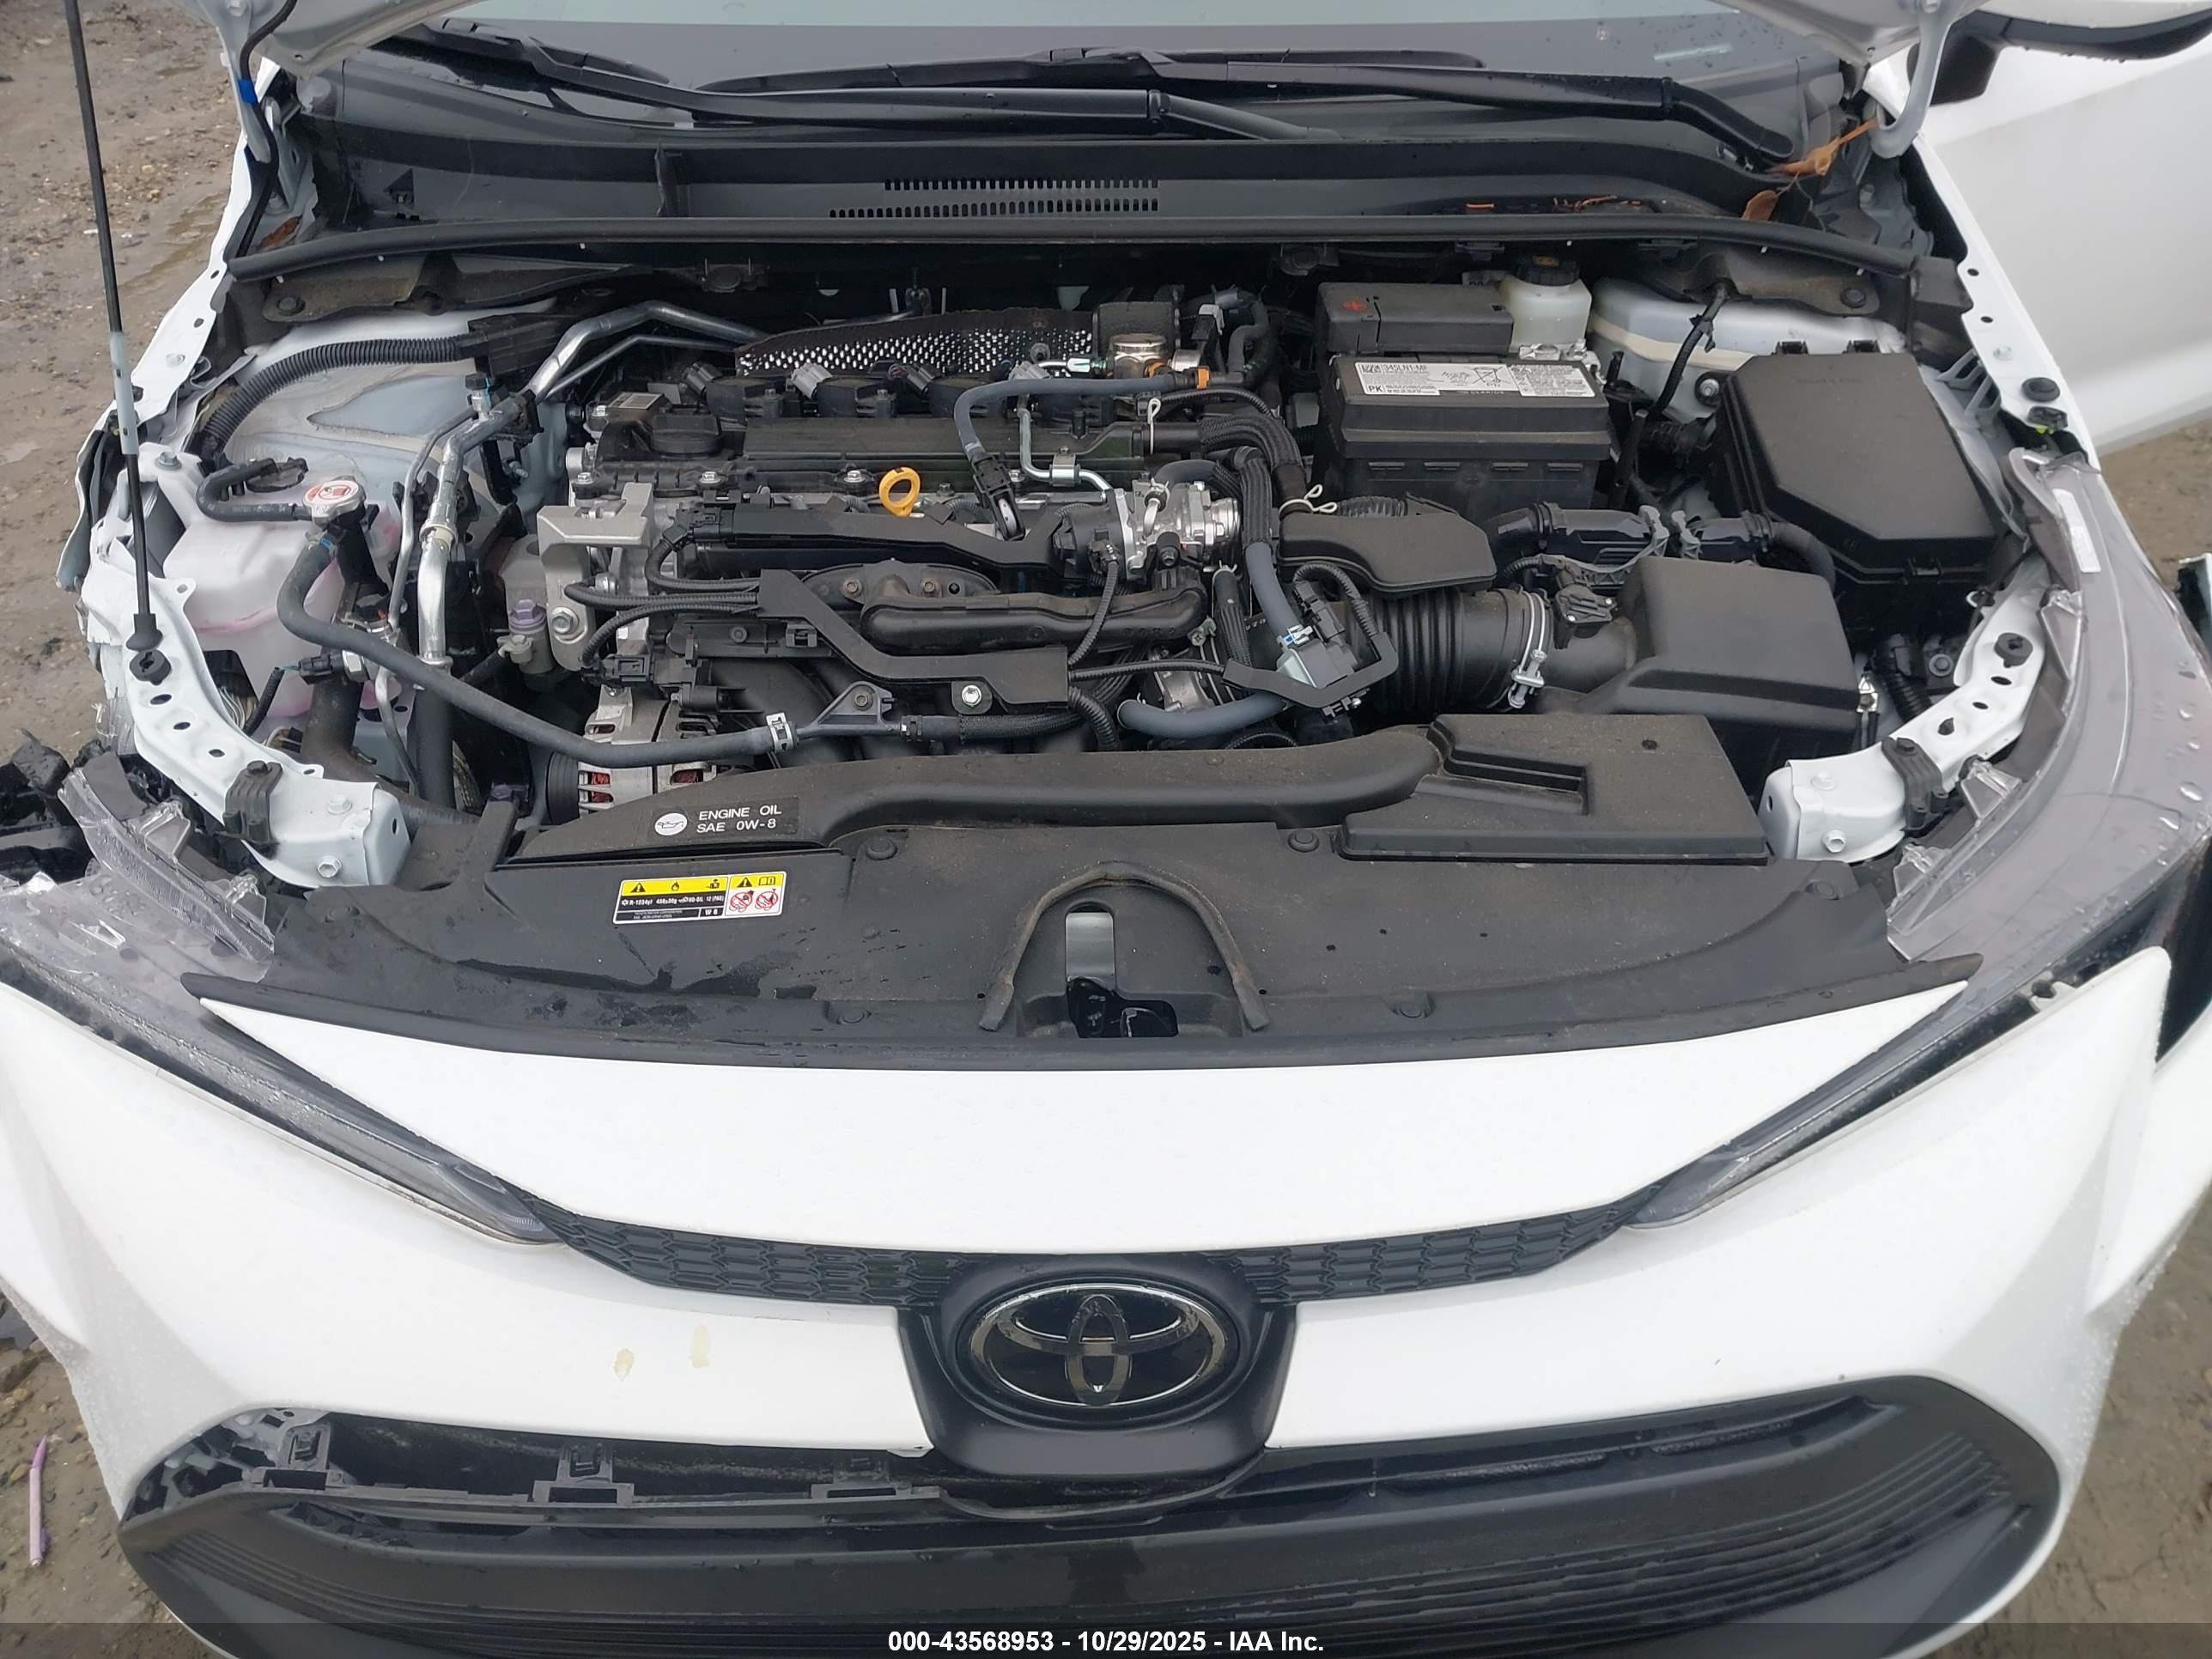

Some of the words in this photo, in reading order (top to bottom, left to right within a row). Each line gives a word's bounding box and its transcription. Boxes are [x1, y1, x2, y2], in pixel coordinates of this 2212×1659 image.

[698, 806, 750, 820] ENGINE
[759, 804, 782, 816] OIL
[696, 822, 726, 834] SAE
[736, 817, 776, 830] 0W-8
